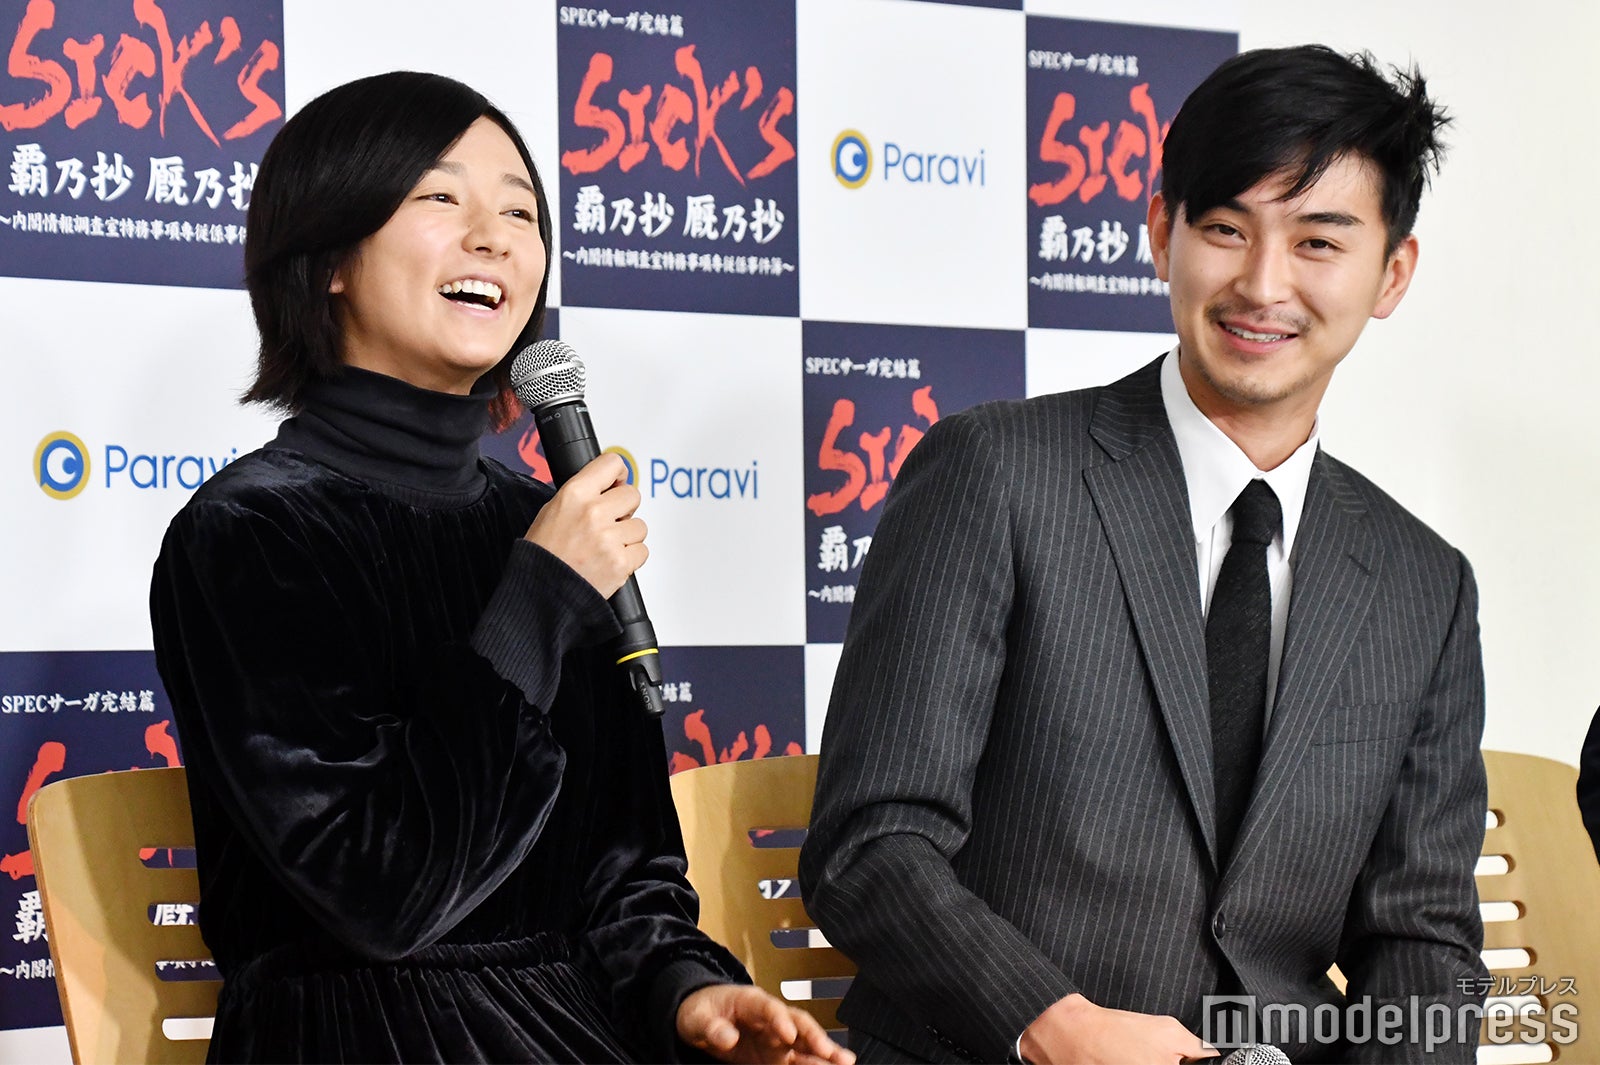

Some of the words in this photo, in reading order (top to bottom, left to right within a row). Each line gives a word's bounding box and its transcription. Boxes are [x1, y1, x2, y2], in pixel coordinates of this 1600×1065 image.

[8, 143, 134, 201] 覇乃抄
[884, 142, 985, 186] Paravi
[573, 185, 675, 238] 覇乃抄
[1038, 215, 1129, 264] 覇乃抄
[105, 444, 238, 490] Para
[650, 458, 759, 500] Paravi
[1, 690, 155, 714] SPECサーガ完結篇
